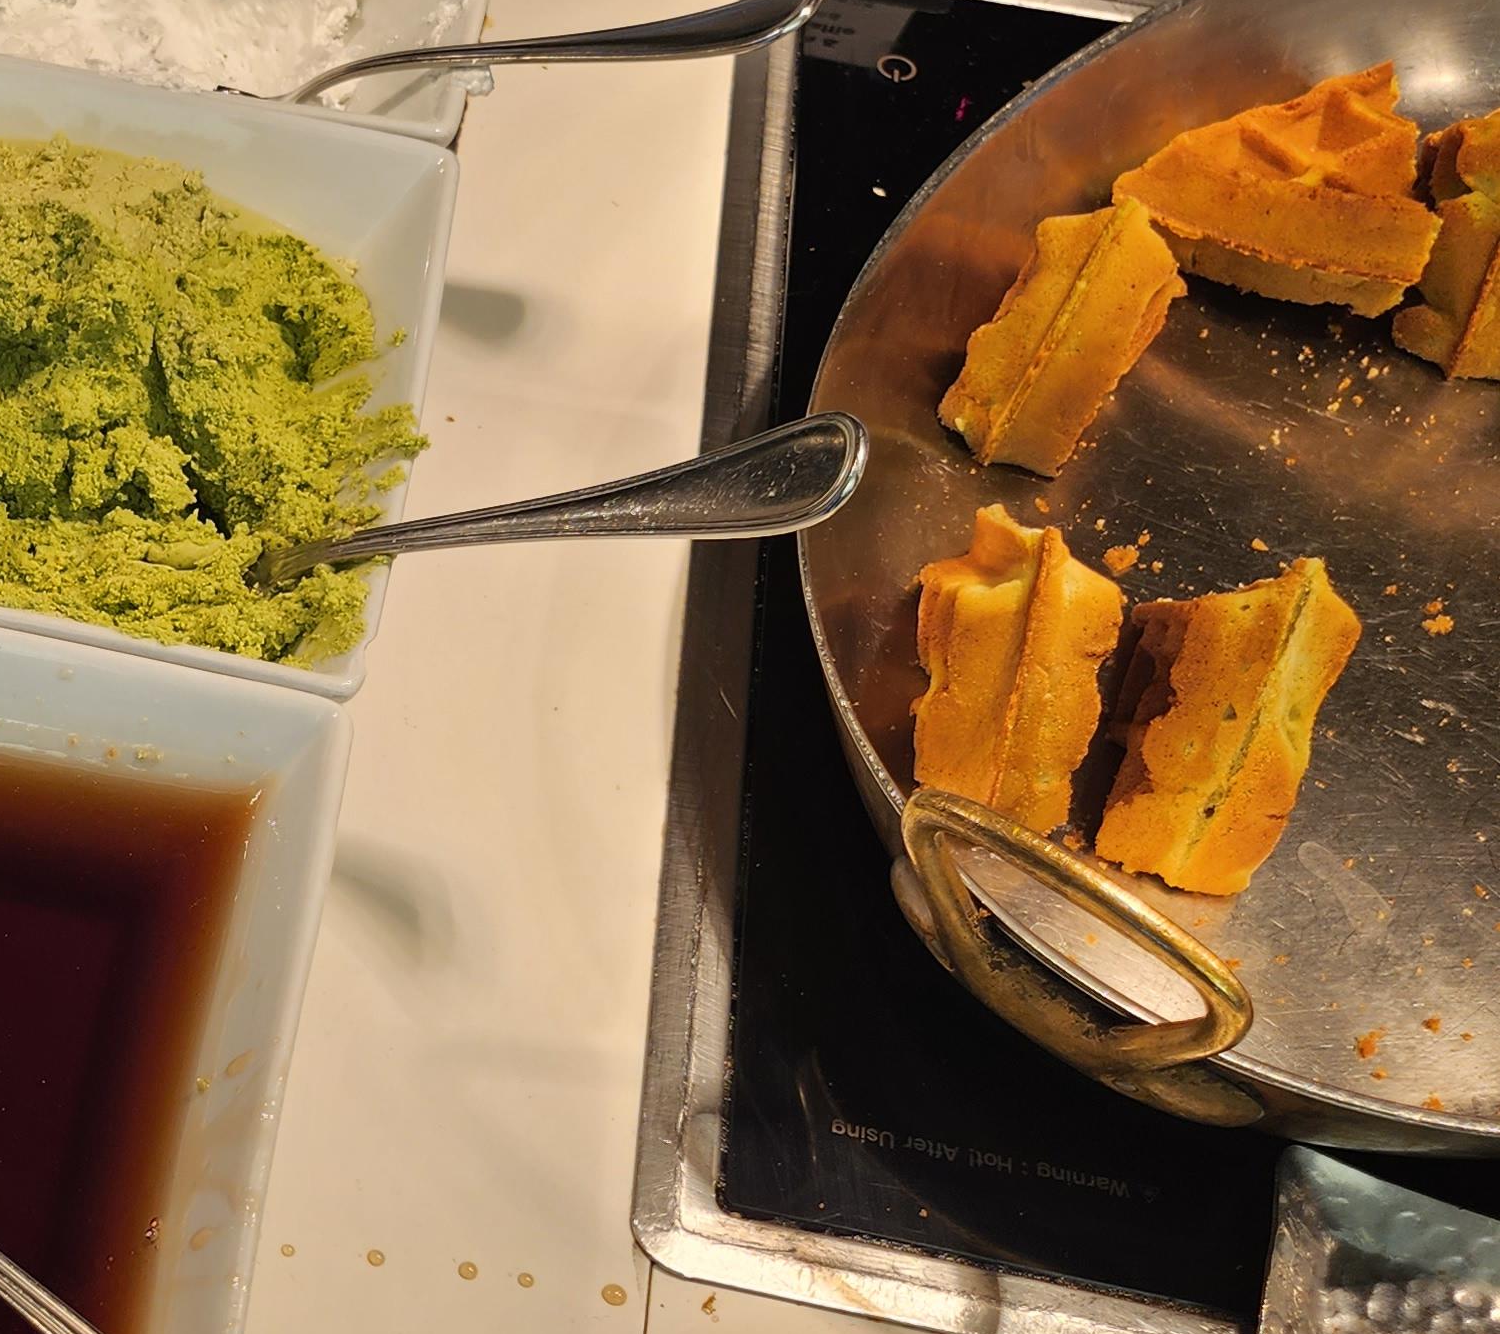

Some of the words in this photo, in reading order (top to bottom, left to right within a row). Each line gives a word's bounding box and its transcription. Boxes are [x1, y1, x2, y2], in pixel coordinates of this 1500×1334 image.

[830, 1118, 895, 1149] Using
[902, 1135, 958, 1162] After
[968, 1148, 1013, 1174] Hot!
[1036, 1161, 1131, 1199] Warning
